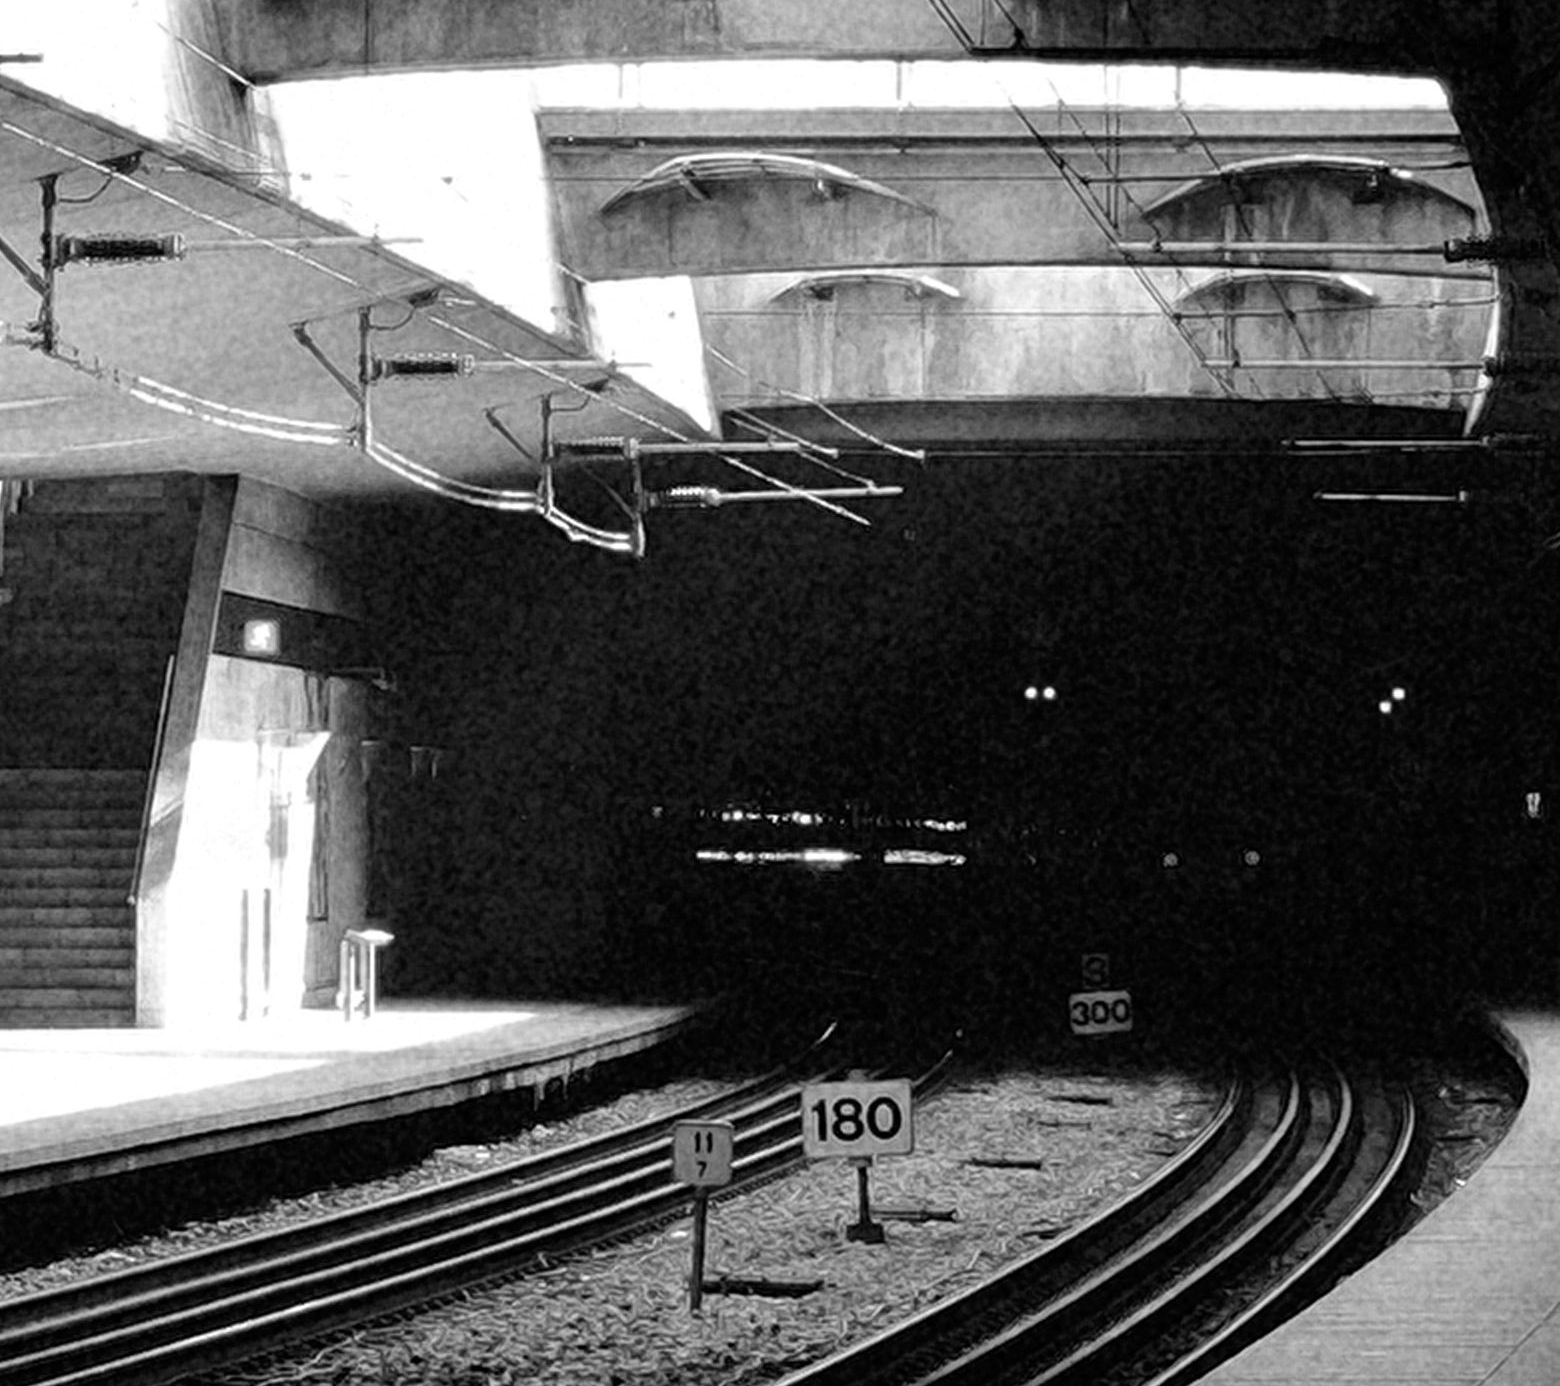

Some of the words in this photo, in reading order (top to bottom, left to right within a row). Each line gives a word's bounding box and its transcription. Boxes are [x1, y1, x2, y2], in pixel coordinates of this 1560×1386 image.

[1073, 999, 1129, 1025] 300
[811, 1097, 902, 1142] 180
[695, 1131, 713, 1154] 11
[695, 1161, 707, 1178] 7
